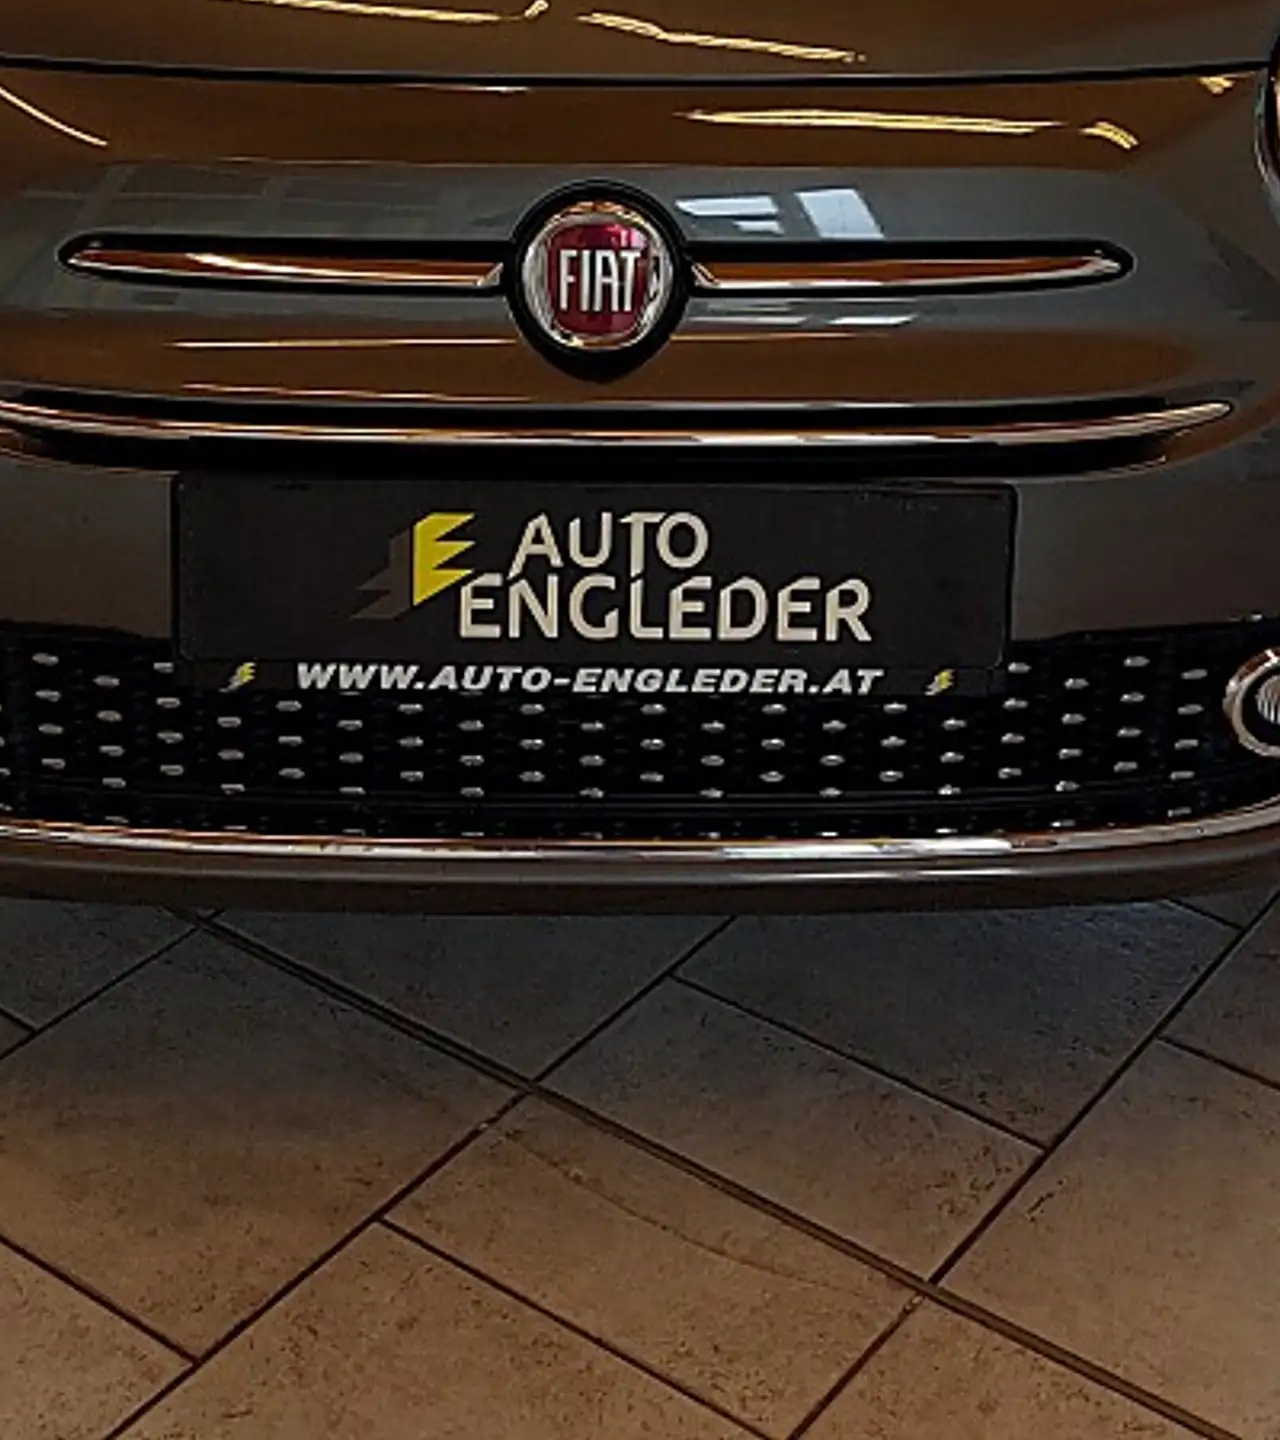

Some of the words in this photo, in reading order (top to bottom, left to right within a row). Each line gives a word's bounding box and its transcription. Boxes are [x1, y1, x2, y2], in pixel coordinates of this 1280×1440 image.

[558, 248, 641, 312] FIAT
[506, 511, 710, 580] AUTO
[459, 572, 873, 642] ENGLEDER
[296, 661, 885, 695] WWW.AUTO-ENGLEDER.AT
